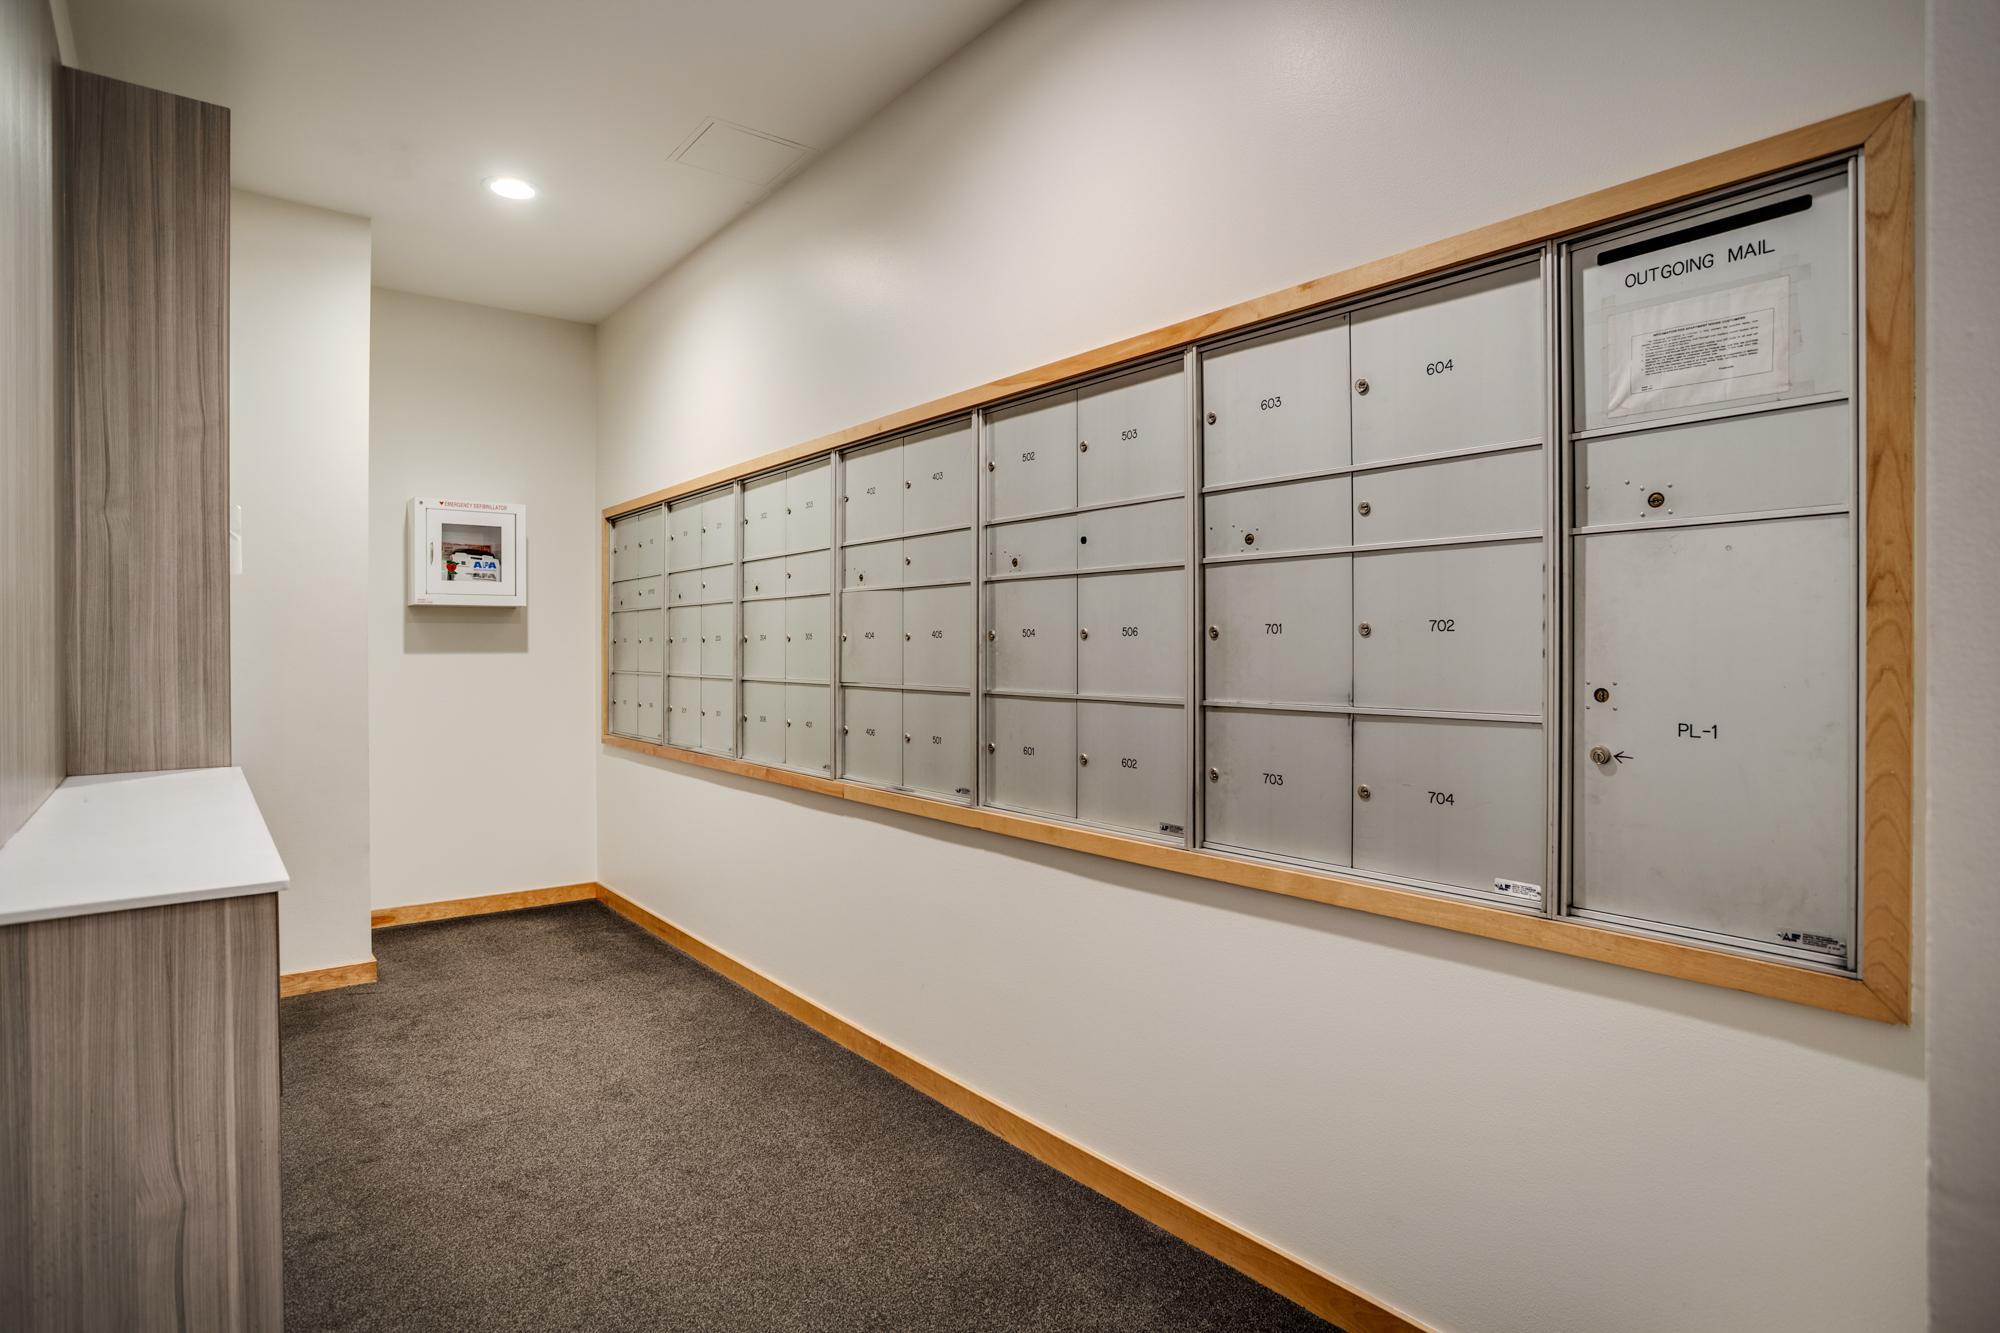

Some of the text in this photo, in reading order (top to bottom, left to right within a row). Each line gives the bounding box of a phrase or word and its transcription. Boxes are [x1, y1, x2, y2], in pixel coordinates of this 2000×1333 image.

[1624, 240, 1775, 288] OUTGOING MAIL
[1426, 358, 1454, 376] 604
[1260, 396, 1282, 411] 603
[1121, 428, 1138, 441] 503
[1022, 451, 1036, 463] 502
[932, 471, 944, 481] 403
[866, 486, 876, 495] 402
[444, 501, 472, 509] EMERGENCY
[1121, 626, 1139, 637] 506
[1264, 623, 1282, 635] 701
[1428, 619, 1456, 633] 702
[864, 631, 875, 640] 404
[931, 630, 943, 639] 405
[1022, 628, 1036, 638] 504
[865, 728, 876, 737] 406
[1678, 723, 1717, 739] PL-1
[932, 735, 942, 745] 501
[1022, 746, 1035, 756] 601
[1121, 757, 1138, 769] 602
[1263, 772, 1284, 786] 703
[1427, 791, 1455, 806] 704
